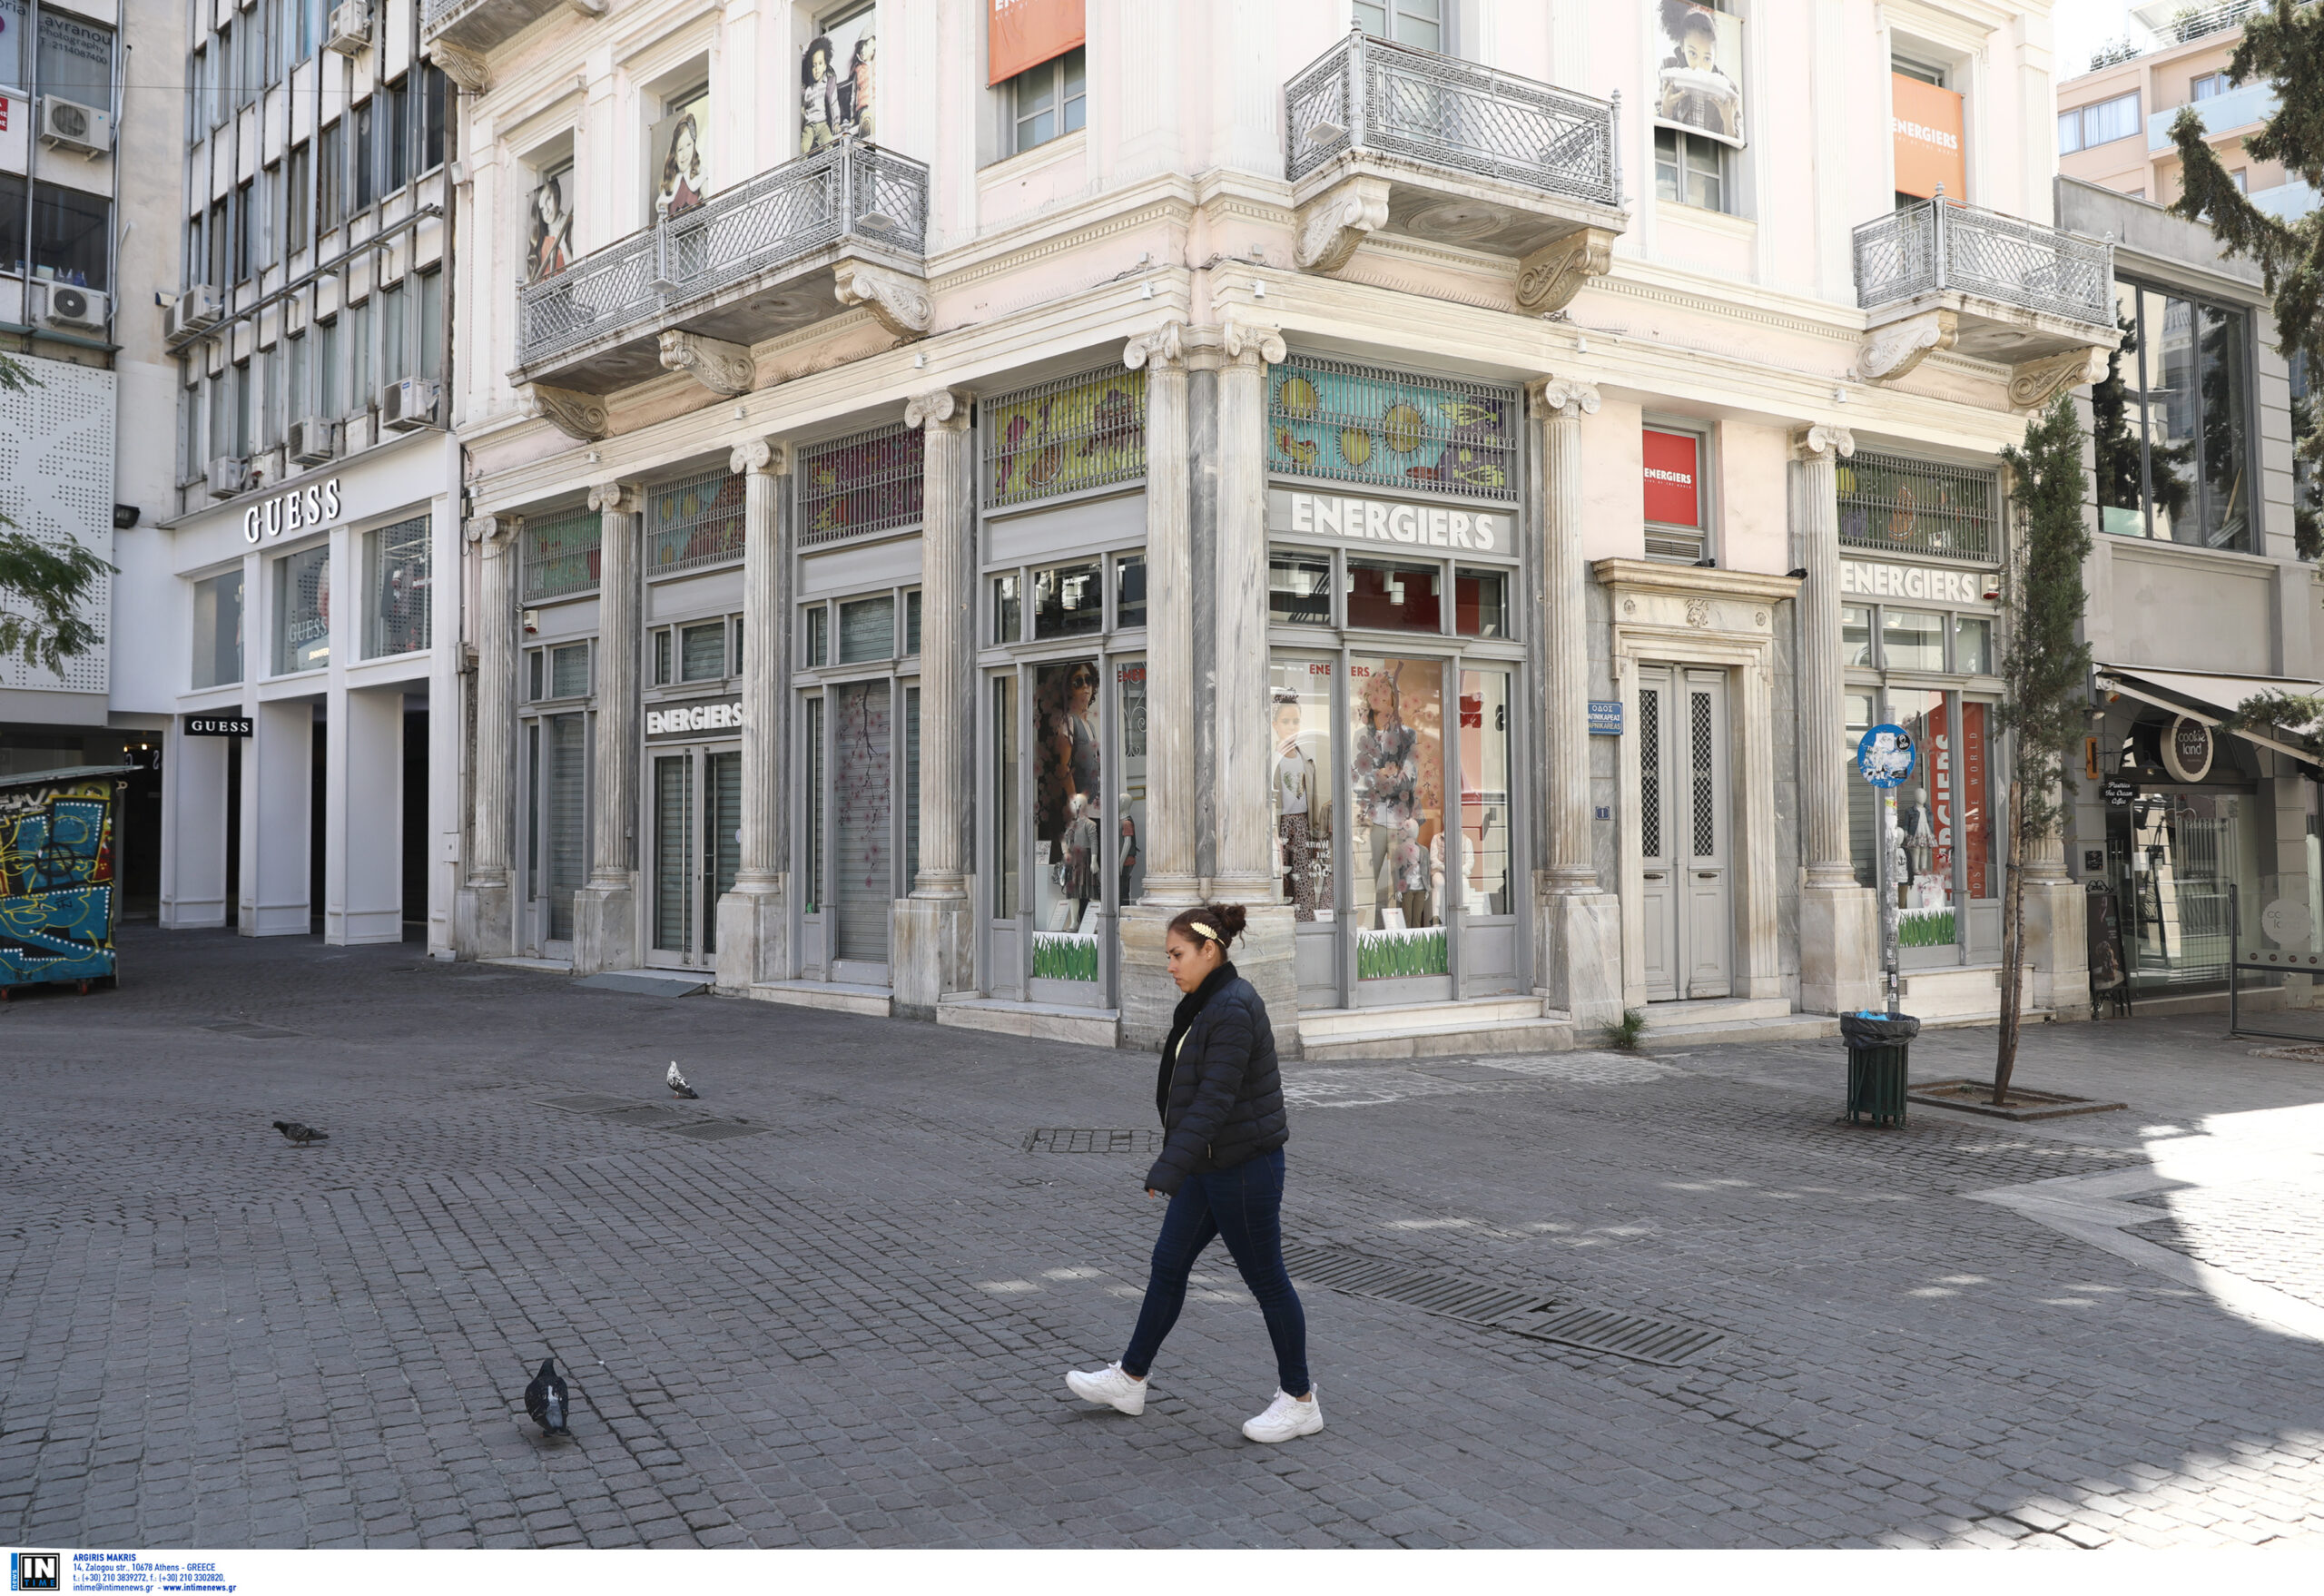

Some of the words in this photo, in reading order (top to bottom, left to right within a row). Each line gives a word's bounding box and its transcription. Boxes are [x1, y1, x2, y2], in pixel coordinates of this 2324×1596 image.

[39, 16, 111, 45] avranou
[1644, 468, 1692, 484] ENERGIERS
[244, 478, 340, 544] GUESS
[1291, 493, 1495, 550] ENERGIERS
[1839, 560, 1975, 604] ENERGIERS
[646, 702, 742, 734] ENERGIERS
[1591, 704, 1613, 713] ΟΔΟΣ
[191, 720, 249, 733] GUESS
[2178, 730, 2206, 743] cookie
[1969, 733, 1980, 785] WORLD
[2182, 743, 2202, 755] land
